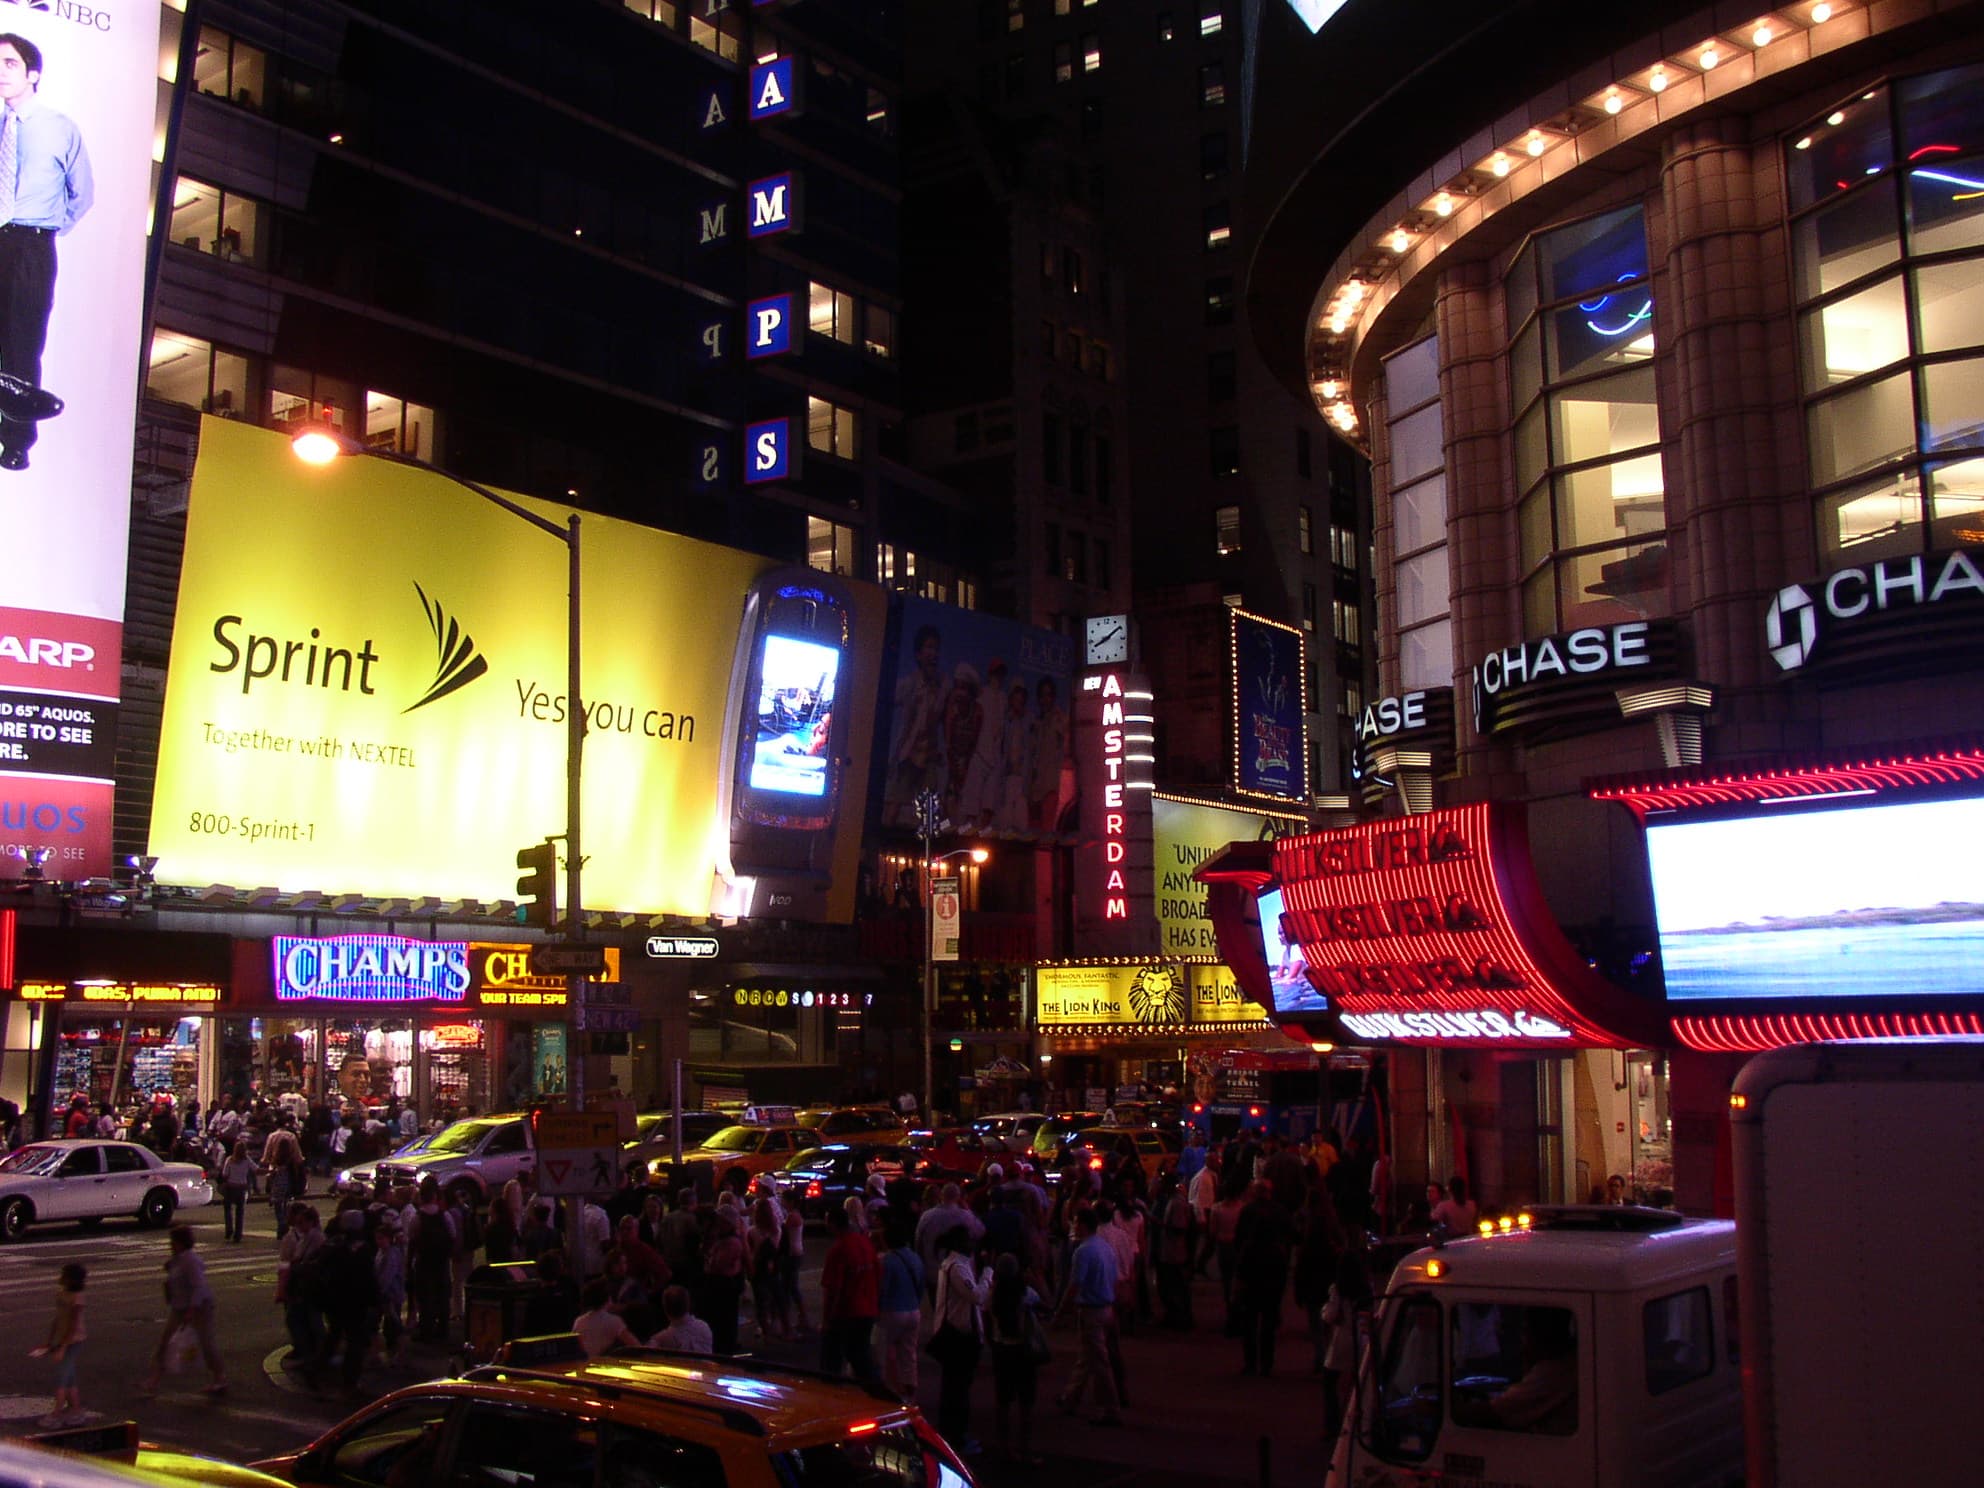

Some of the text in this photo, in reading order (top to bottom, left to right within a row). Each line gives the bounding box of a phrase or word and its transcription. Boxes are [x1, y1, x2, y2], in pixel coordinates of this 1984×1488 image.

[55, 0, 112, 32] NBC
[209, 614, 379, 694] Sprint
[1483, 622, 1649, 695] CHASE
[15, 704, 40, 717] 65"
[42, 707, 95, 724] AQUOS.
[516, 678, 566, 723] Yes
[643, 709, 695, 742] can
[30, 723, 57, 741] TO
[60, 726, 92, 744] SEE
[203, 722, 416, 768] Together with NEXTEL
[1102, 674, 1126, 919] AMSTERDAM
[3, 801, 87, 833] UOS
[189, 811, 316, 843] 800-Sprint-1
[63, 847, 85, 860] SEE
[652, 940, 716, 956] Van Wagner
[1169, 927, 1196, 947] HAS
[285, 943, 471, 993] CHAMPS
[1042, 998, 1120, 1015] THE LION KING
[1197, 985, 1213, 1000] THE
[1340, 1011, 1522, 1039] QUIKSILVER
